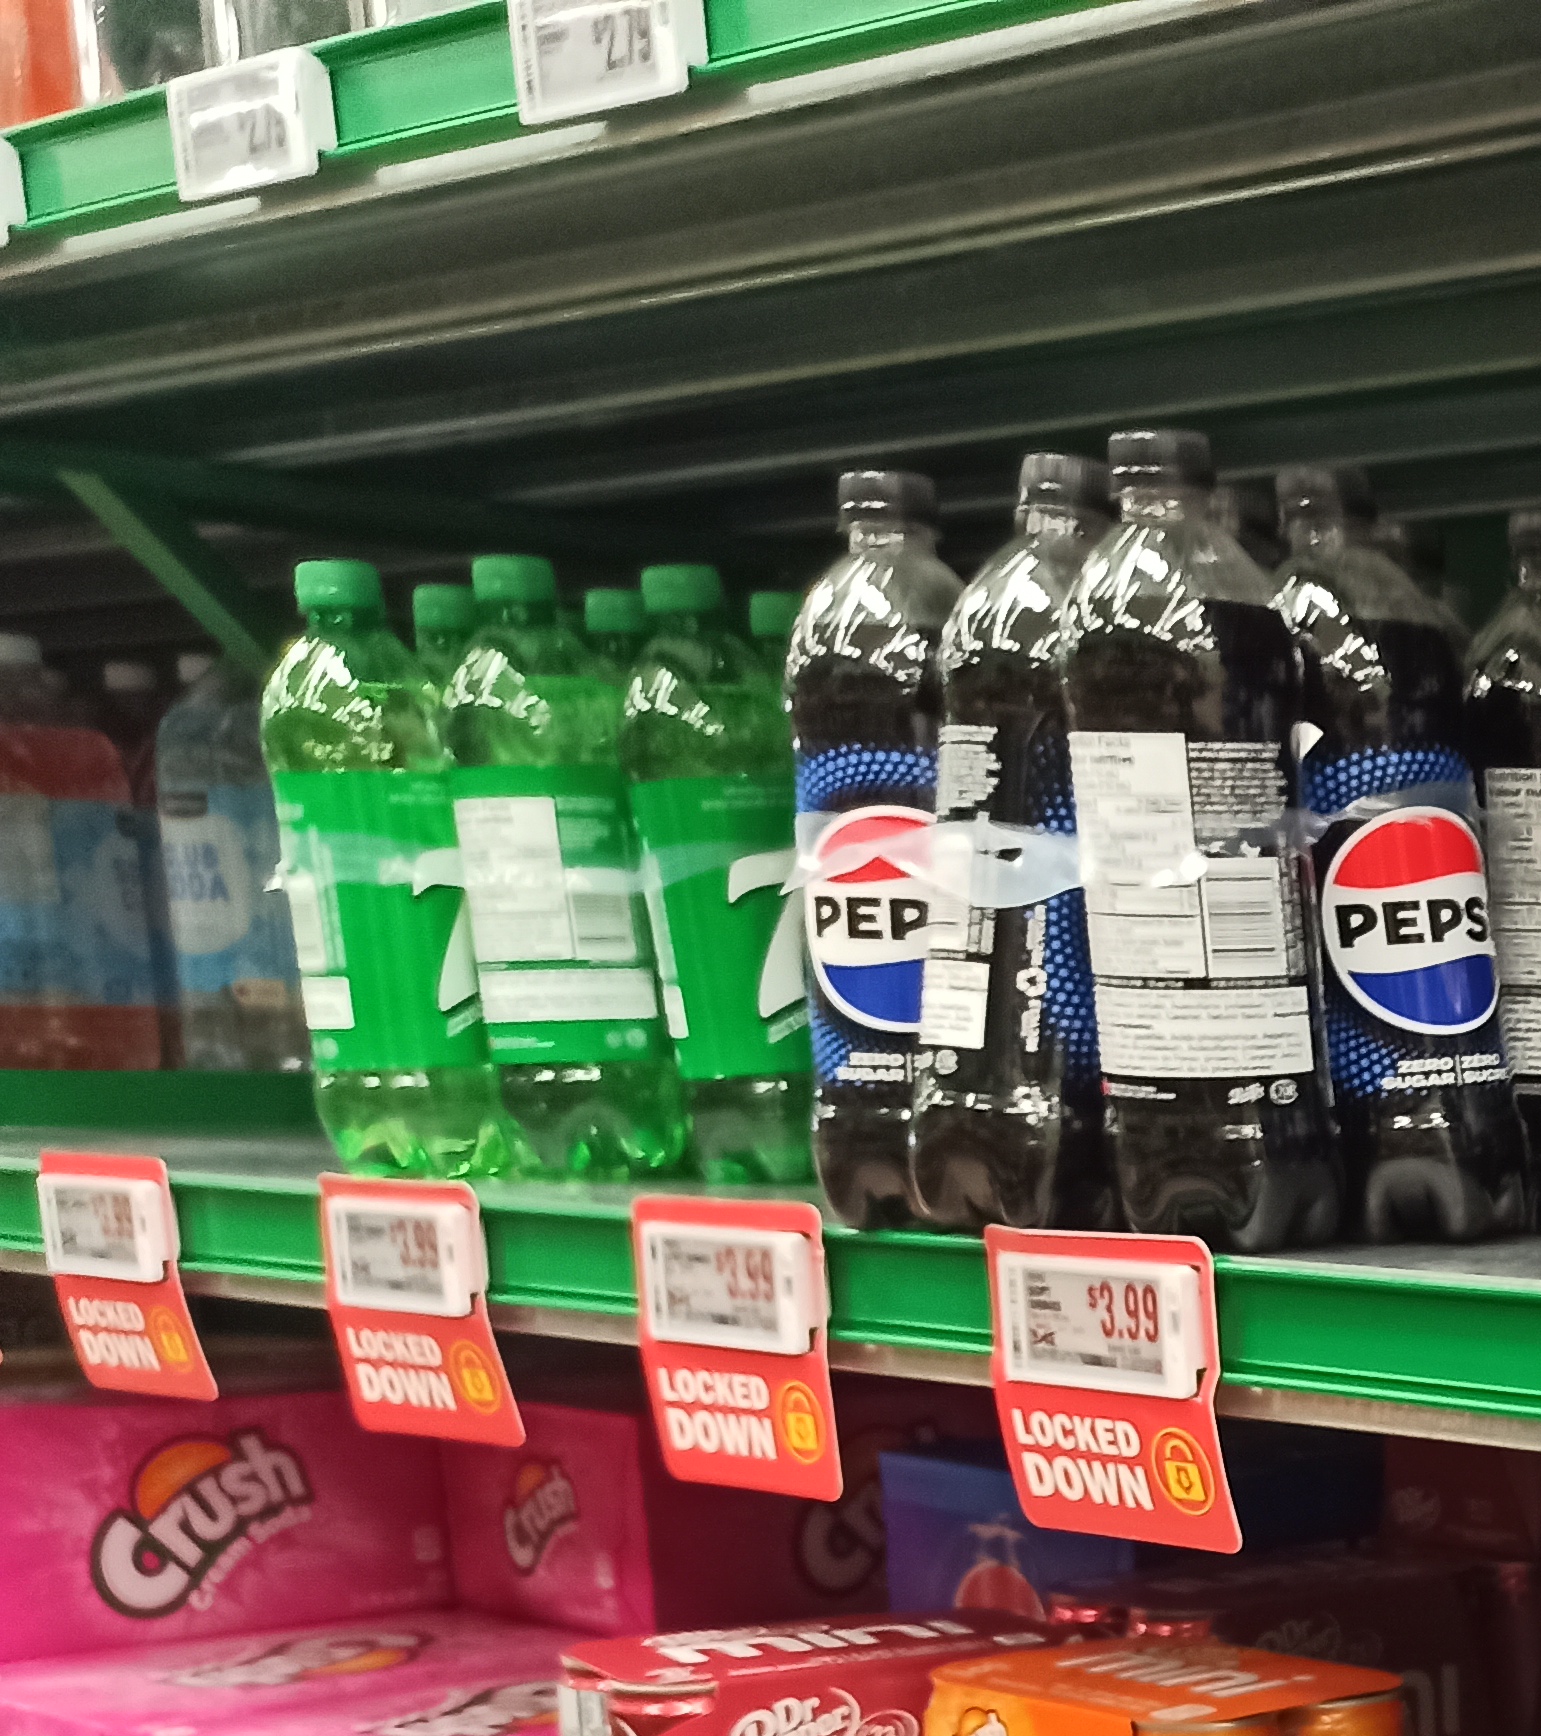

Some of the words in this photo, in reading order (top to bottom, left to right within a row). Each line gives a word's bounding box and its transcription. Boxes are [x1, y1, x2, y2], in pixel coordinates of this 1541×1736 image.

[815, 895, 929, 941] PEP
[1336, 897, 1488, 949] PEPS
[67, 1296, 146, 1333] LOCKED
[1087, 1281, 1161, 1344] $3.99
[81, 1329, 161, 1372] DOWN
[346, 1327, 443, 1368] LOCKED
[357, 1363, 458, 1411] DOWN
[658, 1366, 770, 1412] LOCKED
[667, 1411, 778, 1461] DOWN
[1012, 1408, 1141, 1459] LOCKED
[1022, 1455, 1155, 1512] DOWN
[97, 1432, 310, 1612] Crush
[771, 1696, 821, 1728] Dr
